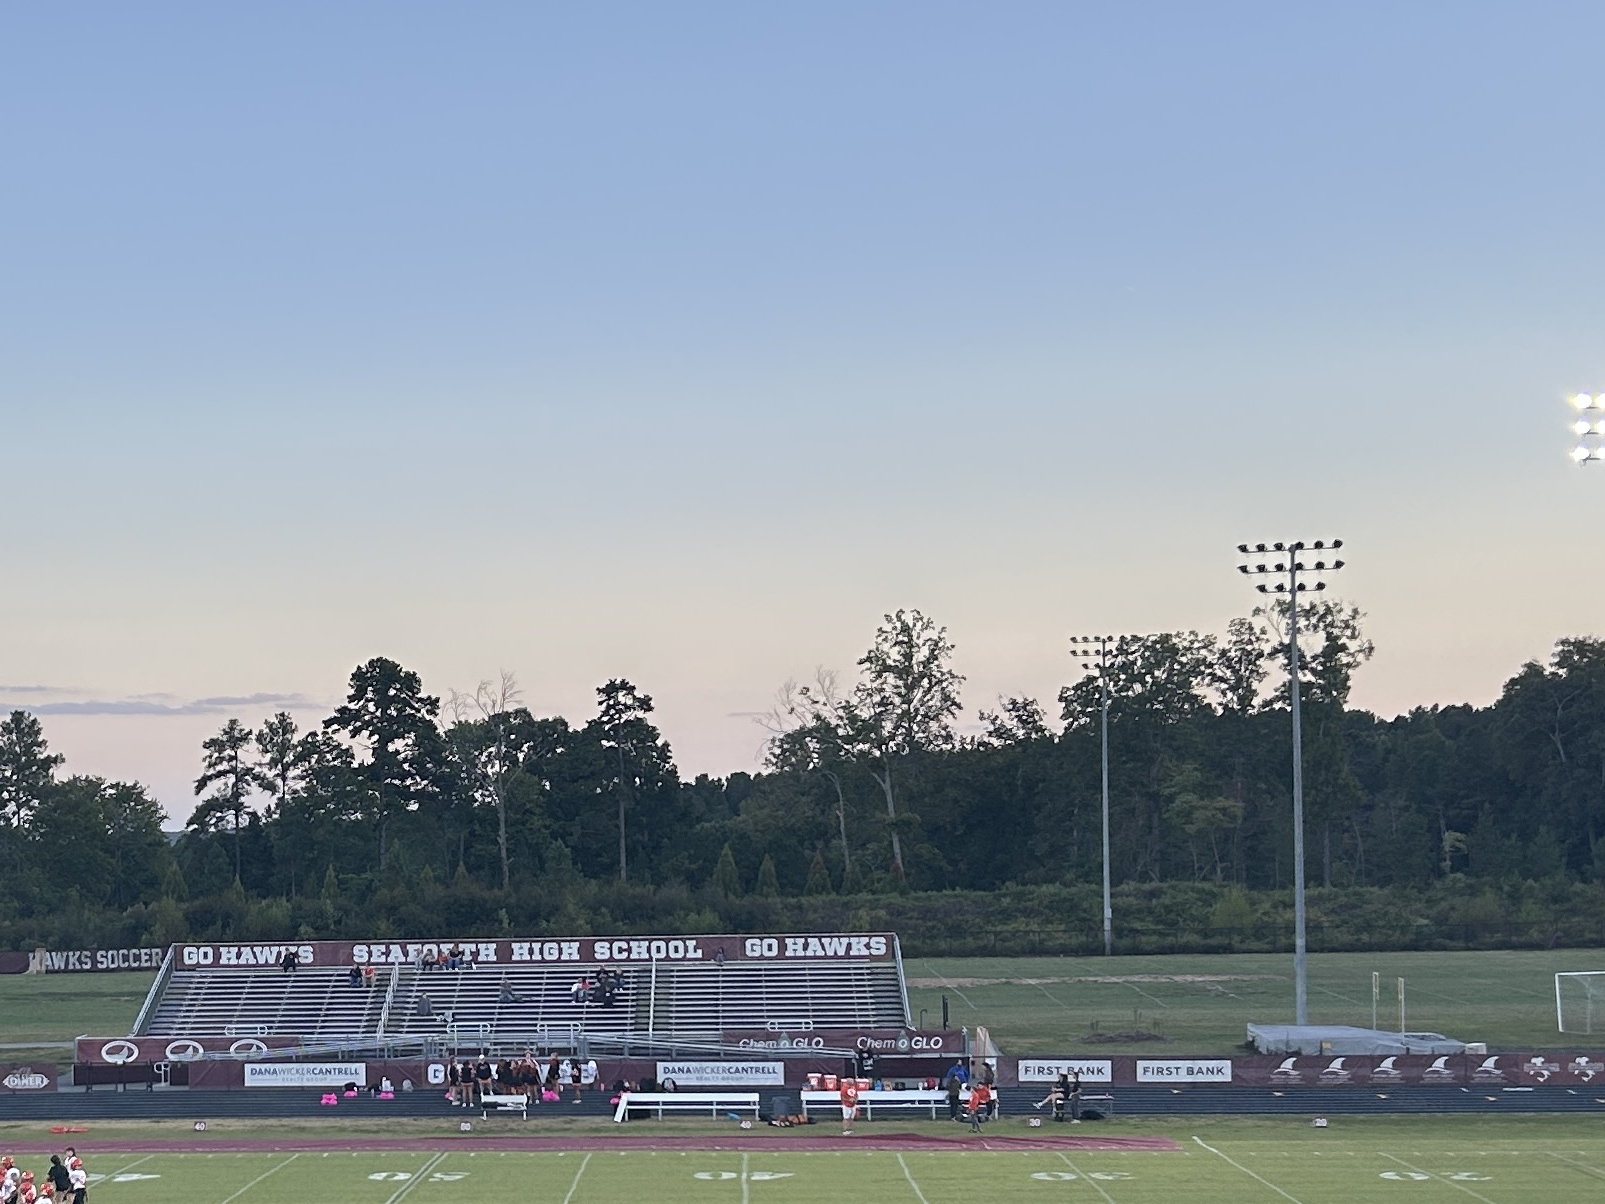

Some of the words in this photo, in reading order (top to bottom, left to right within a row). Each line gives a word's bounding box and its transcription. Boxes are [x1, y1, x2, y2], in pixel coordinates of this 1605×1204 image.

[183, 946, 214, 964] GO
[511, 942, 580, 961] HIGH
[594, 940, 702, 960] SCHOOL
[745, 938, 778, 957] GO
[785, 936, 887, 956] HAWKS
[96, 948, 163, 969] SOCCER
[1024, 1066, 1061, 1076] FIRST
[1067, 1066, 1105, 1076] BANK
[1143, 1066, 1179, 1076] FIRST
[1186, 1066, 1225, 1076] BANK
